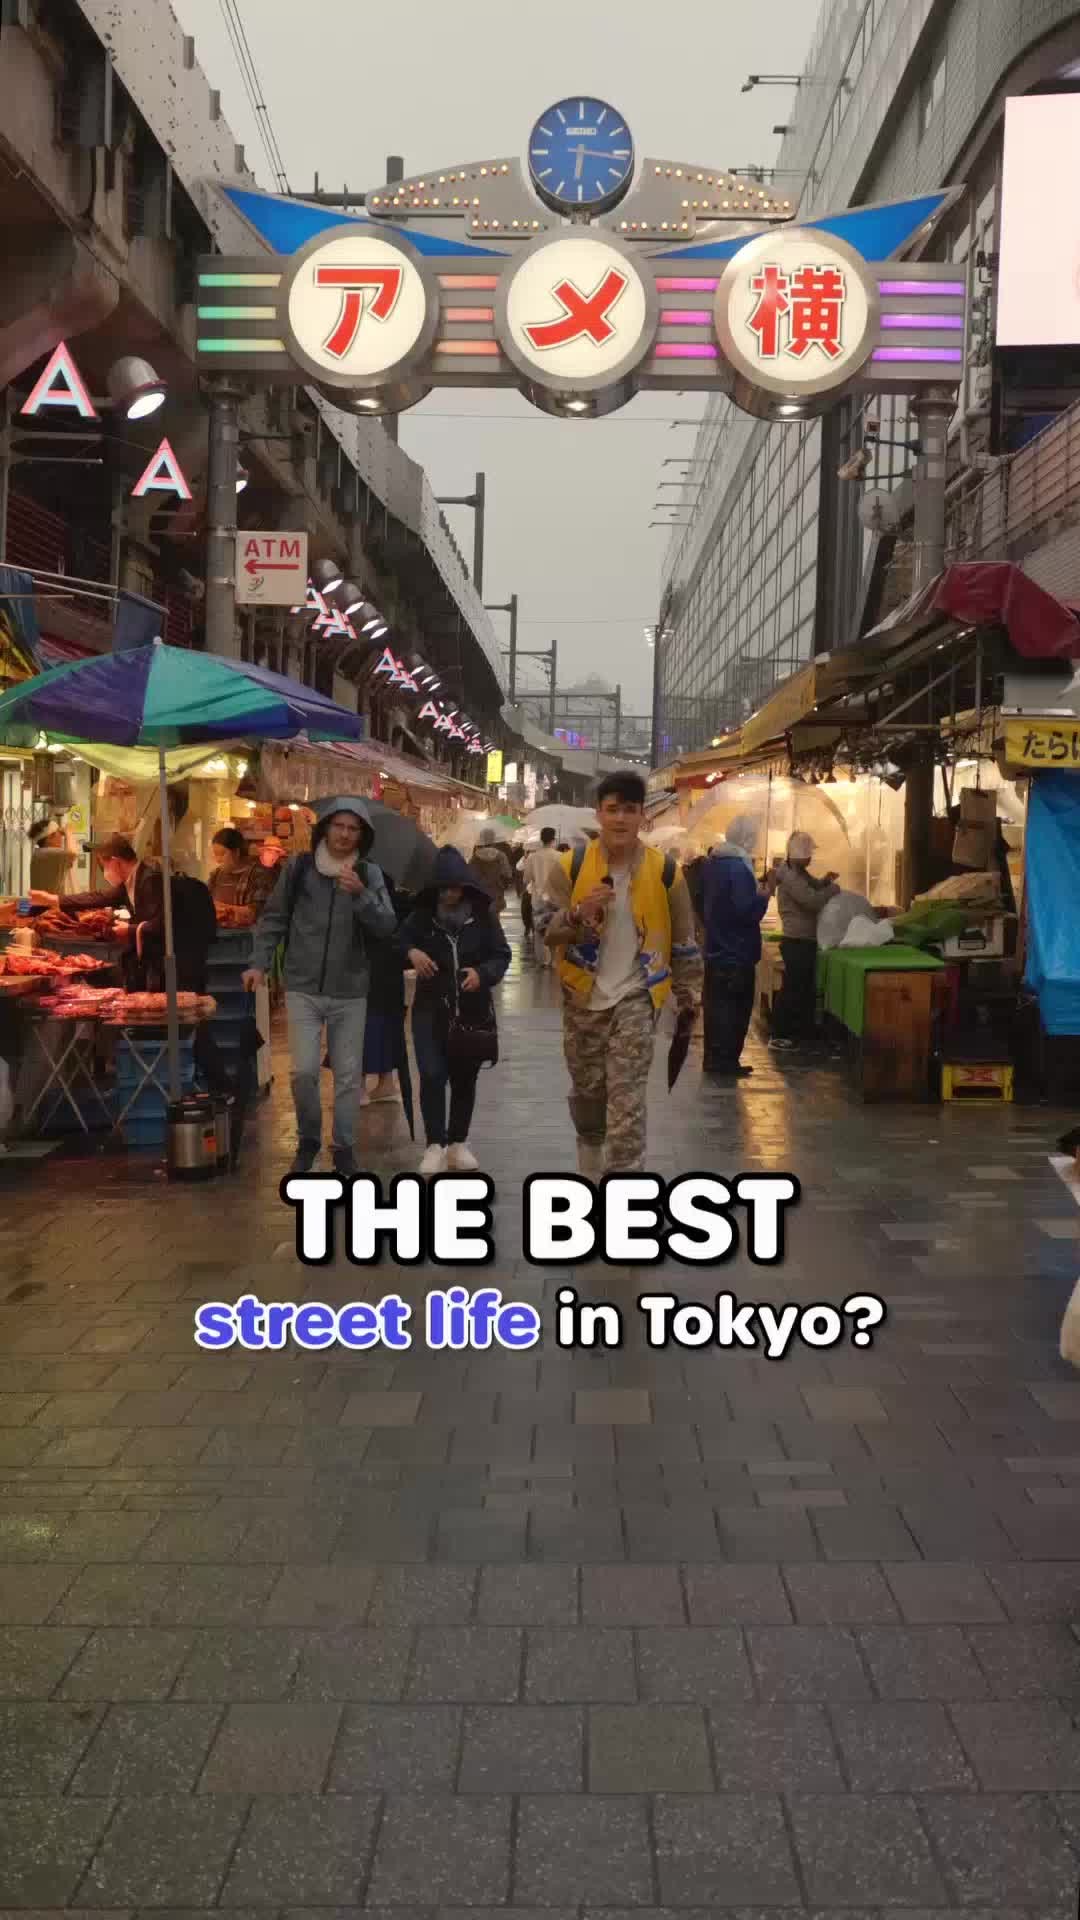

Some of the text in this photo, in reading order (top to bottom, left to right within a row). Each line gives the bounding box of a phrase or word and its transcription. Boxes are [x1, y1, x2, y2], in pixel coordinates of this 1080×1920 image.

[315, 264, 846, 359] アメ横
[21, 342, 96, 417] A
[132, 438, 193, 500] A
[244, 538, 301, 558] ATM
[373, 648, 400, 674] A
[417, 701, 440, 718] A
